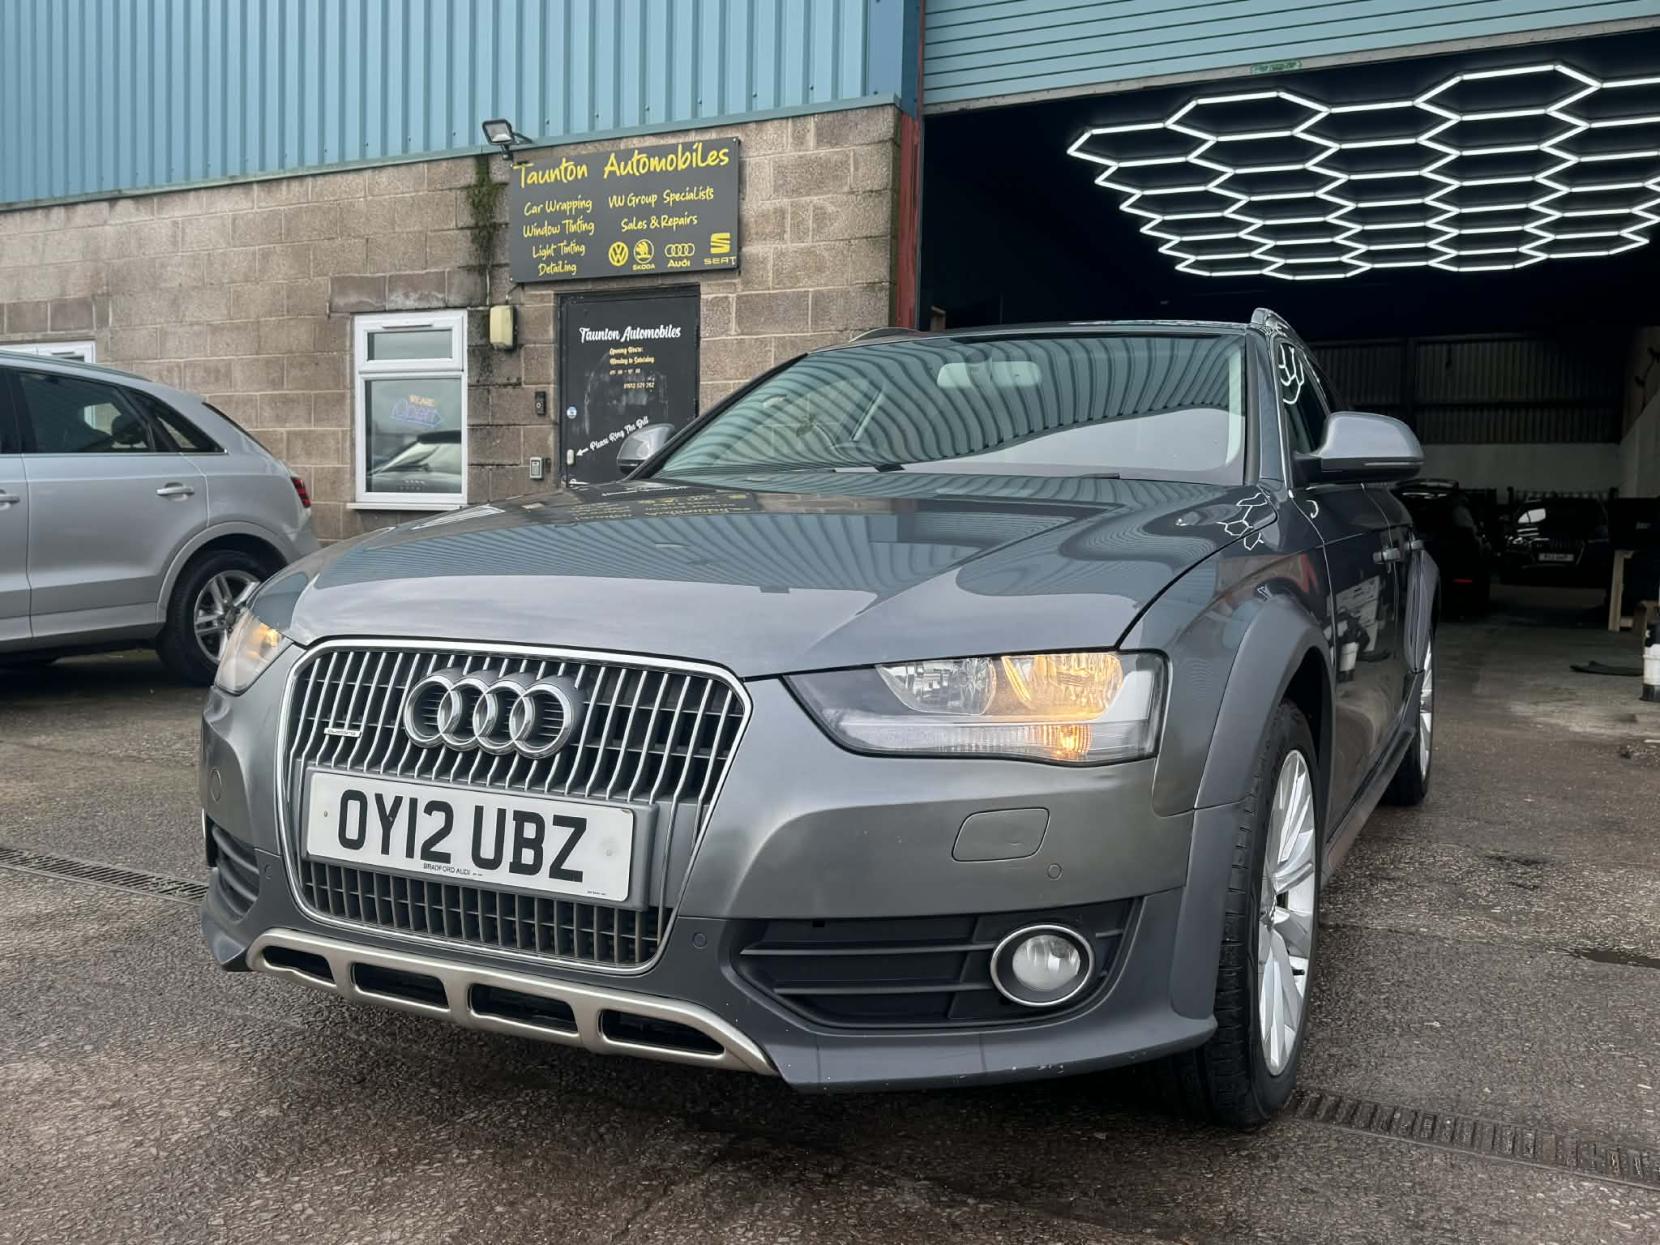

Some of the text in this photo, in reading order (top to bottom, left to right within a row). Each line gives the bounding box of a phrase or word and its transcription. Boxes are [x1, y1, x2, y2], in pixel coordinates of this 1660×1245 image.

[512, 142, 729, 189] Taunton Automobiles
[524, 194, 592, 216] Car Wrapping
[608, 186, 714, 209] VW Group Specialists
[523, 215, 594, 237] Window Tinting
[621, 211, 698, 232] Sales & Repairs
[532, 240, 585, 260] Light Tinting
[704, 256, 737, 265] SEAT
[538, 260, 577, 276] Detailing
[667, 259, 690, 268] Audi
[579, 324, 681, 344] Taunton Automobiles
[338, 789, 588, 883] OY12 UBZ
